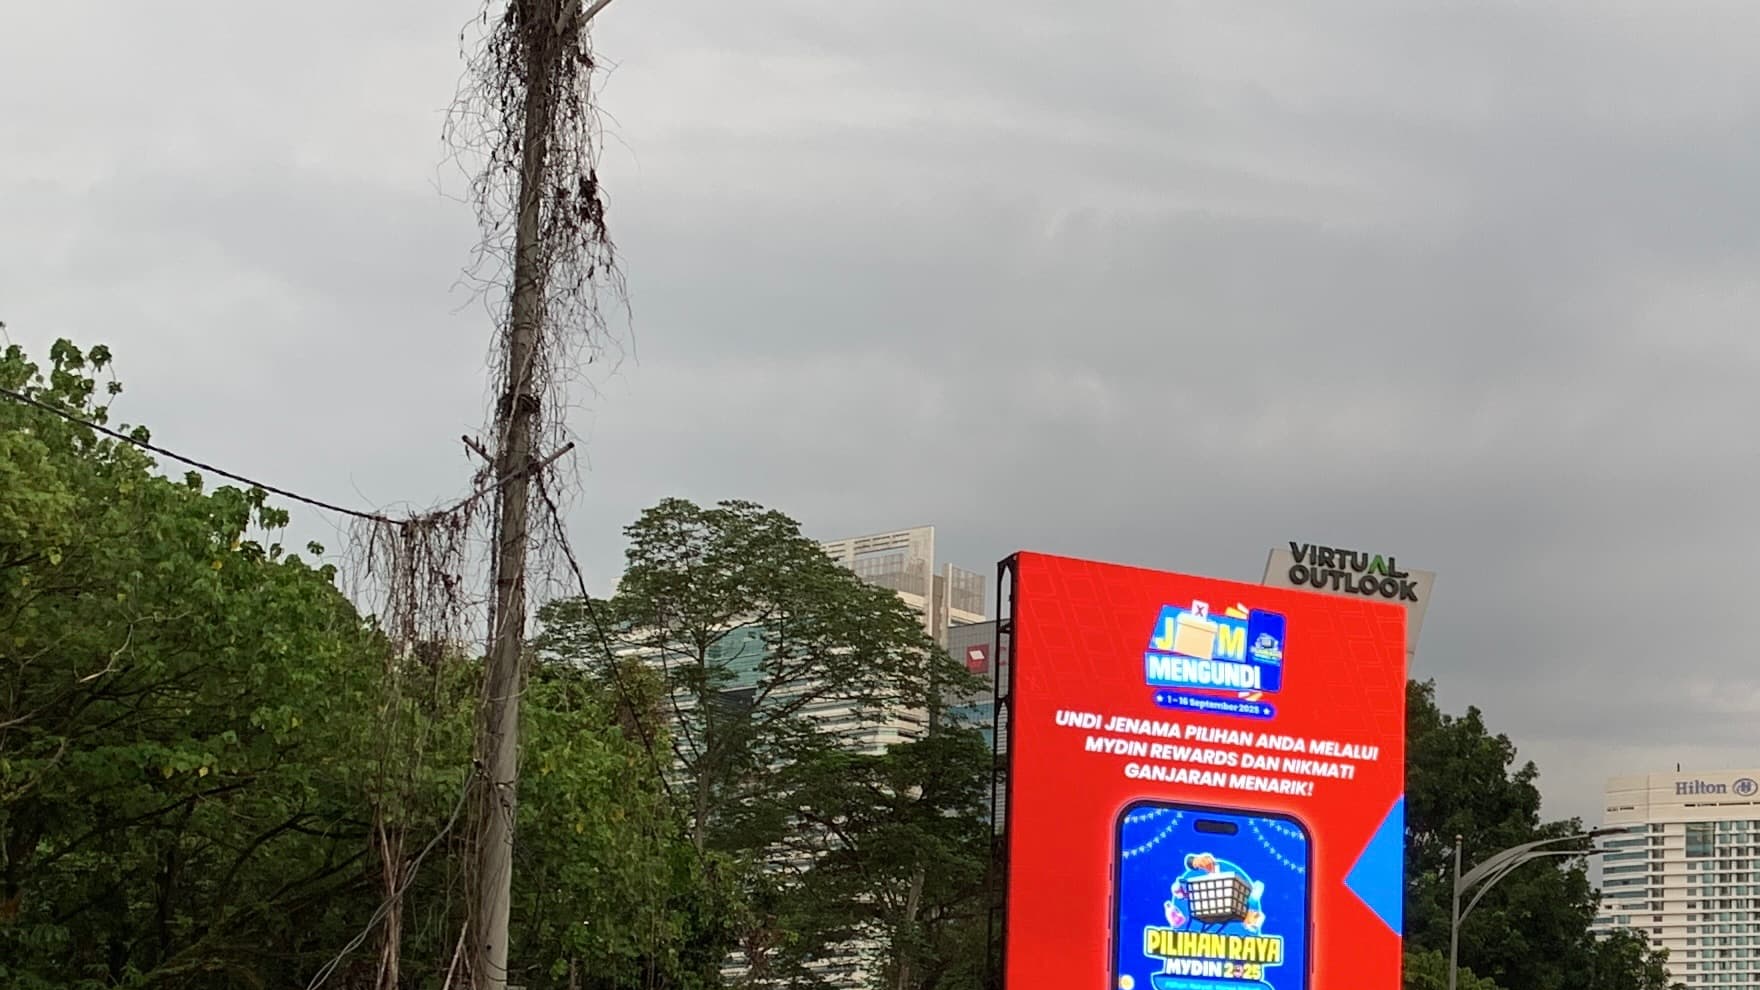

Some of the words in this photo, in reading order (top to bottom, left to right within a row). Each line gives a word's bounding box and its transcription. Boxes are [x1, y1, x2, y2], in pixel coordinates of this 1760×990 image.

[1289, 541, 1409, 578] VIRTUAL
[1289, 564, 1418, 602] OUTLOOK
[1148, 655, 1261, 689] MENGUNDI
[1190, 698, 1239, 712] September
[1055, 710, 1102, 730] UNDI
[1104, 716, 1181, 739] JENAMA
[1184, 724, 1254, 747] PILIHAN
[1256, 734, 1306, 753] ANDA
[1309, 740, 1379, 761] MELALUI
[1085, 736, 1148, 757] MYDIN
[1150, 743, 1239, 767] REWARDS
[1241, 752, 1279, 772] DAN
[1282, 757, 1355, 780] NIKMATI
[1124, 762, 1226, 788] GANJARAN
[1229, 773, 1314, 796] MENARIK!
[1675, 780, 1727, 795] Hilton
[1147, 930, 1226, 959] PILIHAN
[1229, 936, 1280, 962] RAYA
[1166, 958, 1222, 977] MYDIN
